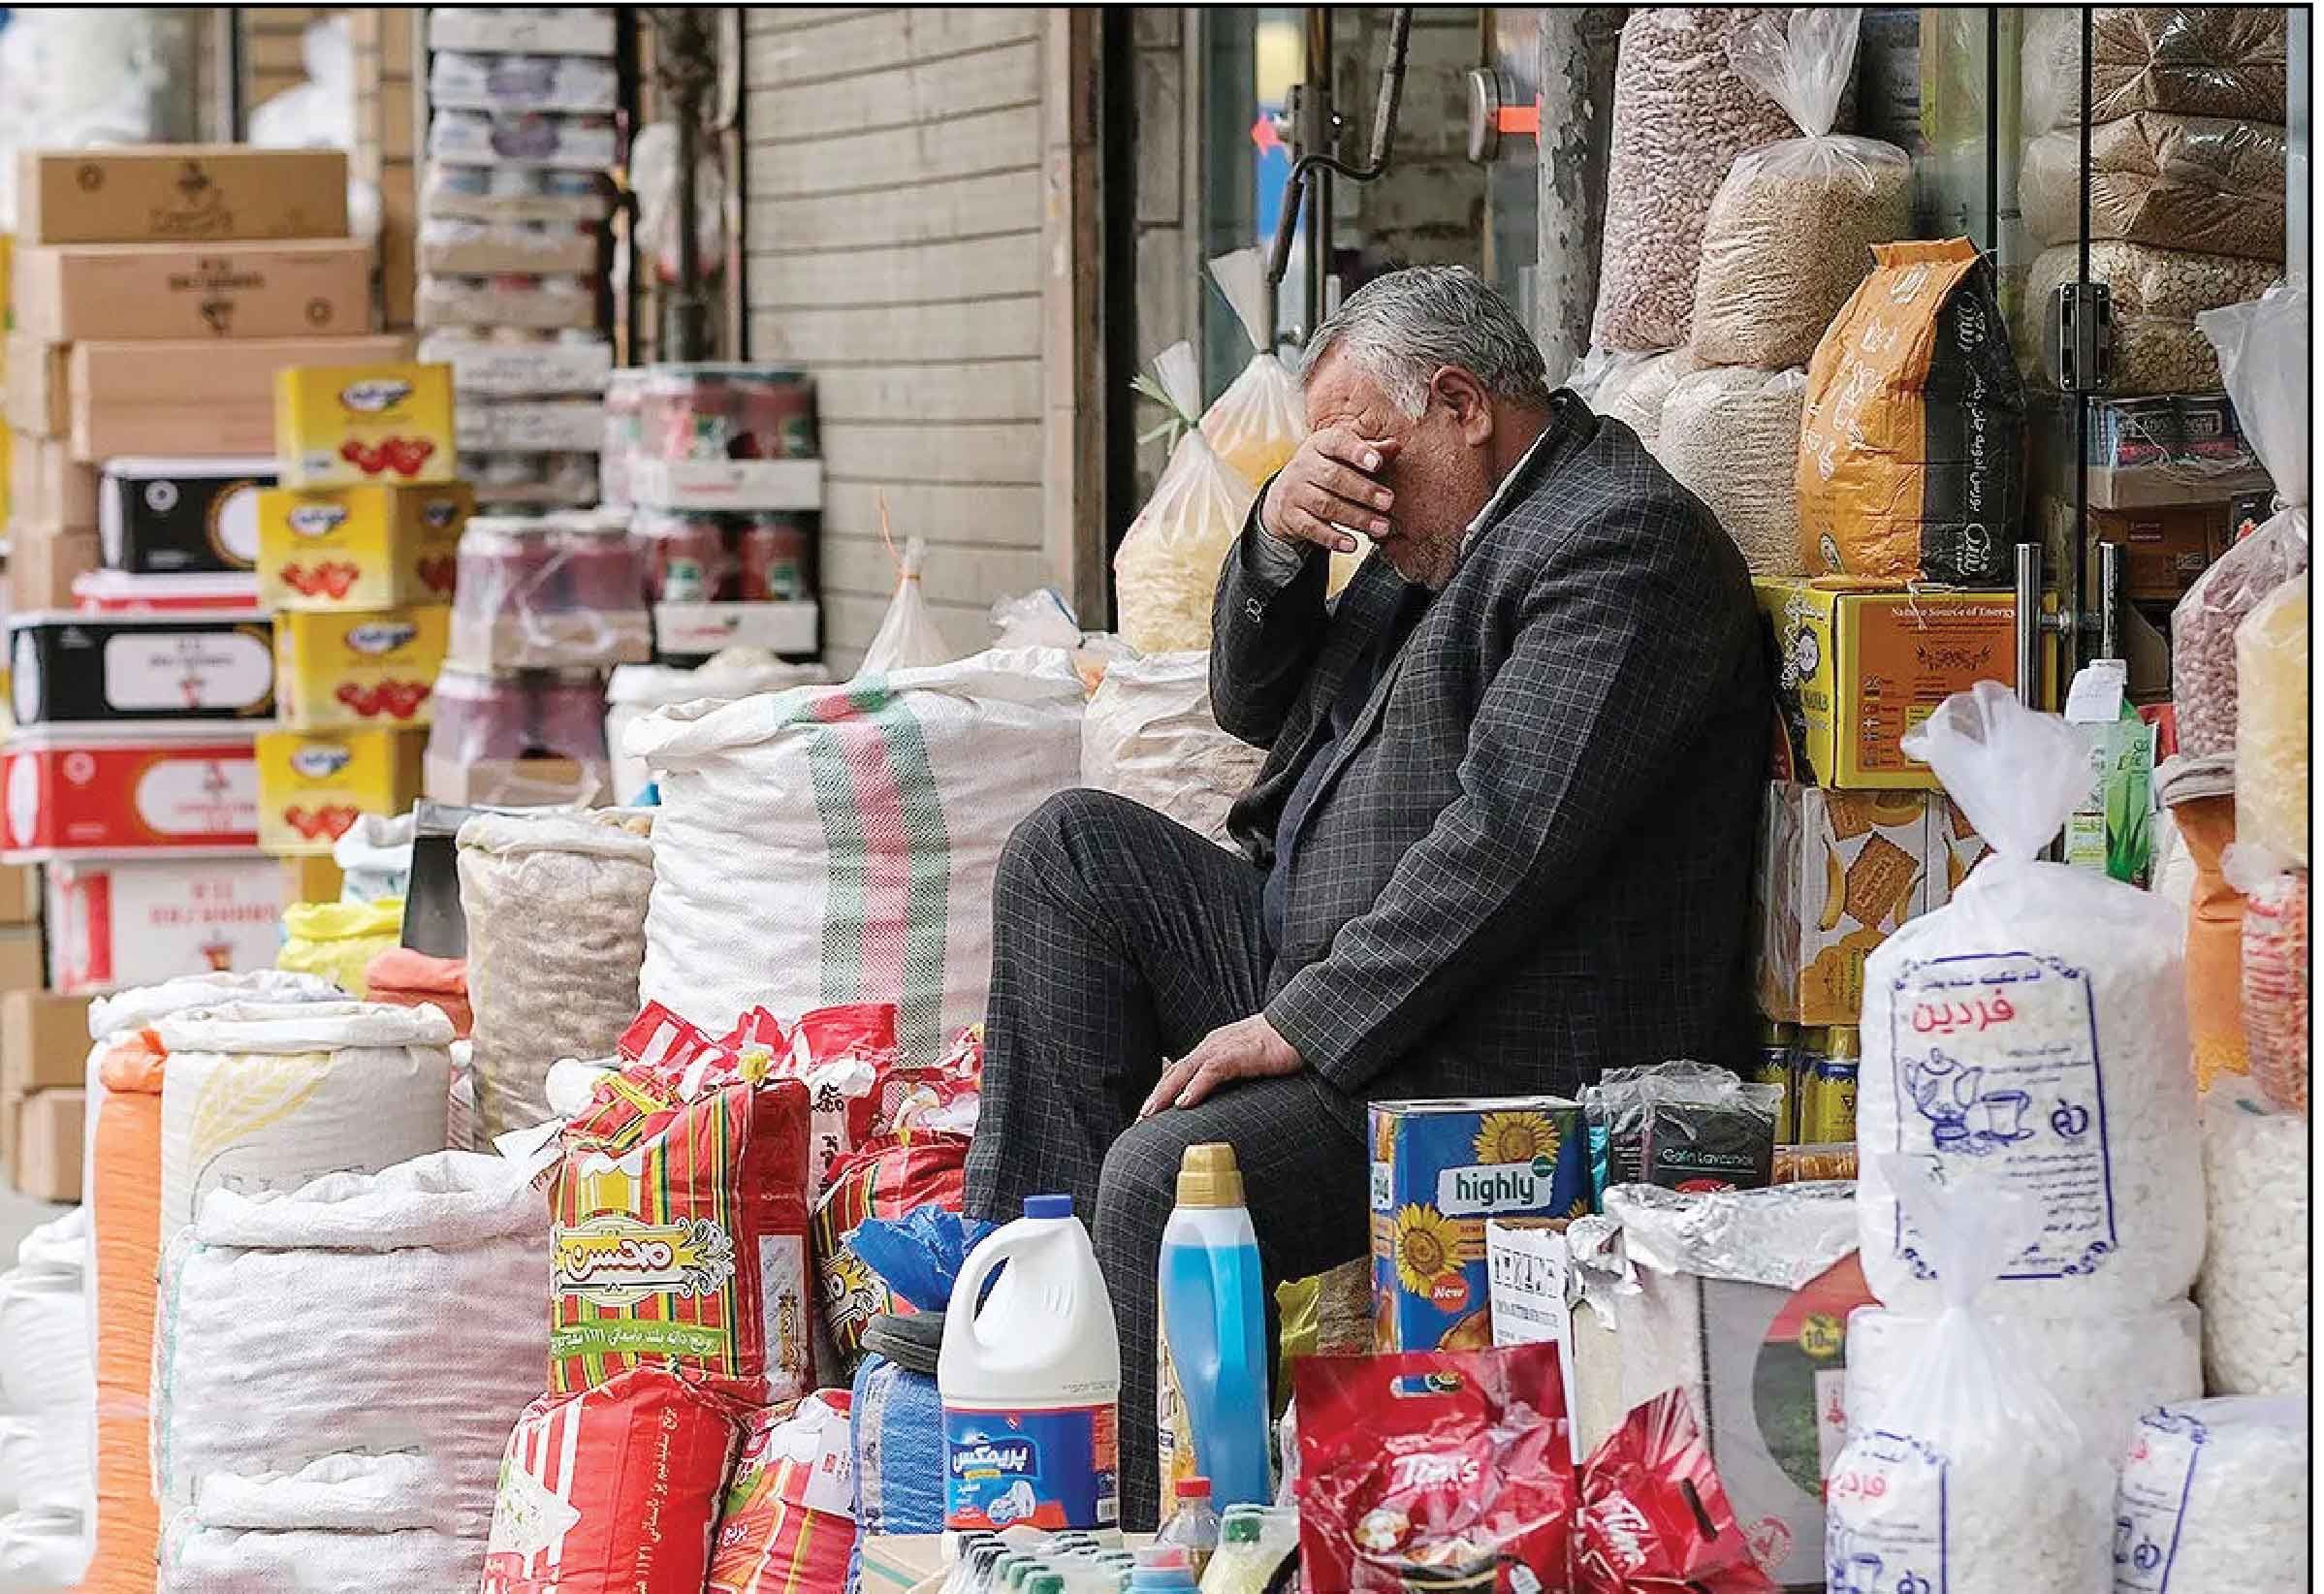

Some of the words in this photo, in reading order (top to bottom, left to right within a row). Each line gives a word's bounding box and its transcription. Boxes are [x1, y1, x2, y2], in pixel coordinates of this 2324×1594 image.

[1979, 607, 2016, 619] Energy
[1913, 987, 2016, 1034] فردین
[1456, 1171, 1535, 1206] highly
[566, 1239, 673, 1282] محسن
[1433, 1288, 1465, 1301] New
[1829, 1468, 1887, 1501] فردی
